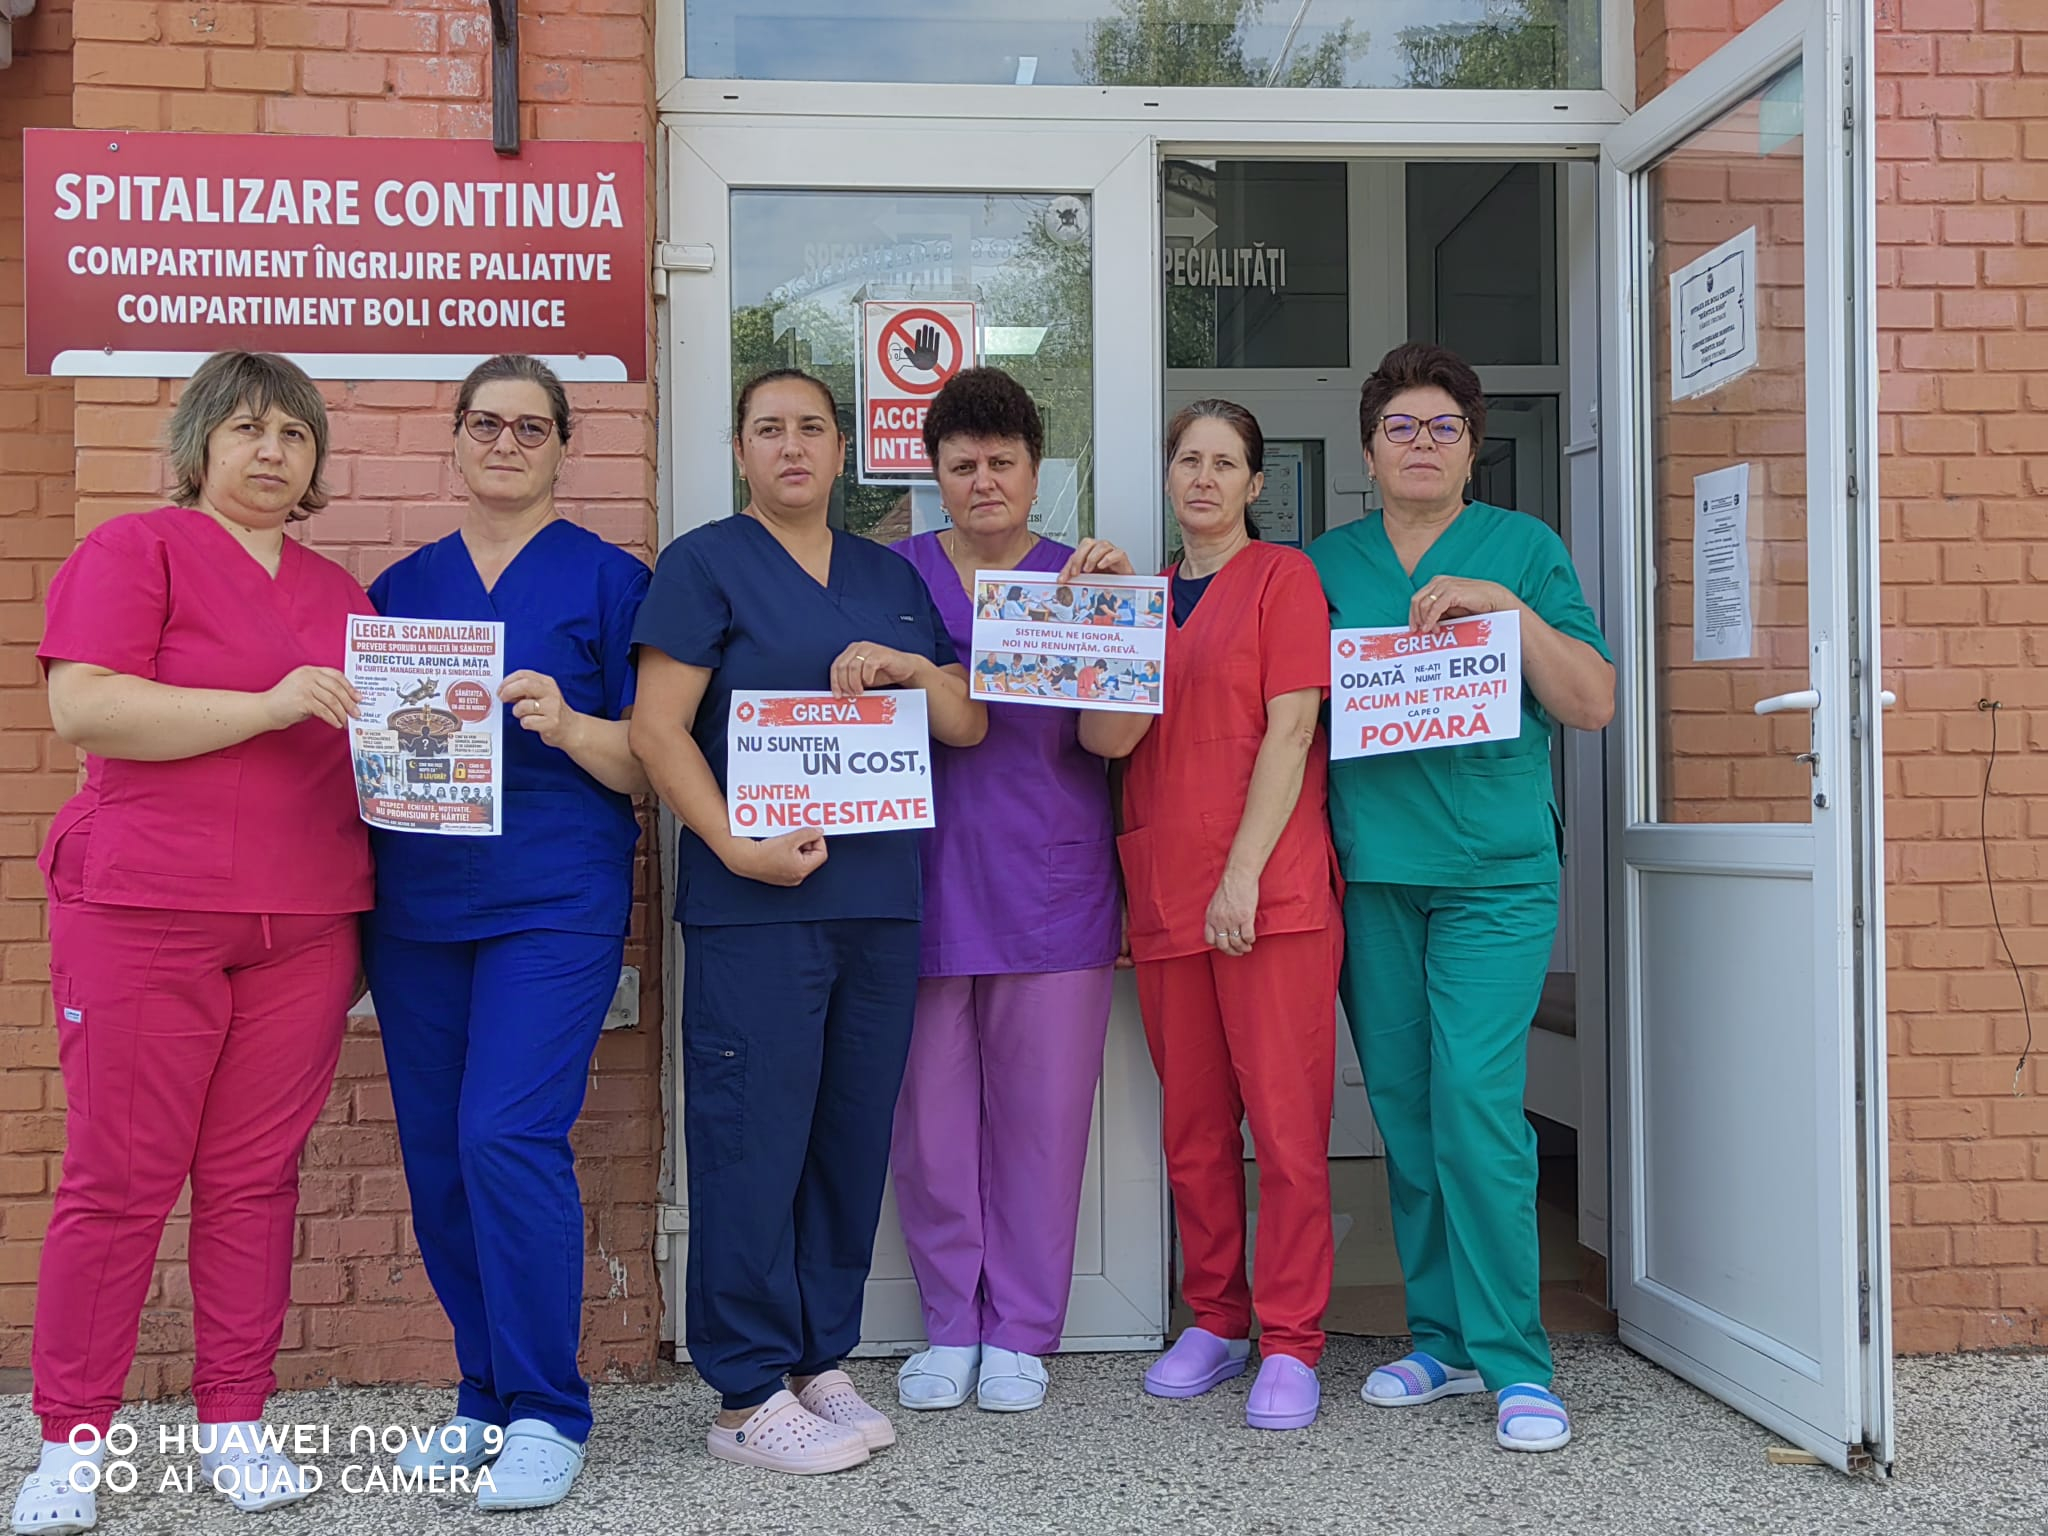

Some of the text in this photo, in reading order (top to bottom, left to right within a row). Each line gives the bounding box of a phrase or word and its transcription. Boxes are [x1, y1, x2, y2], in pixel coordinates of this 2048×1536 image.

[54, 172, 624, 228] SPITALIZARE CONTINUĂ
[68, 243, 612, 281] COMPARTIMENT ÎNGRIJIRE PALIATIVE
[1165, 241, 1286, 295] PECIALITĂȚI
[117, 294, 567, 328] COMPARTIMENT BOLI CRONICE
[873, 407, 929, 430] ACCE
[355, 623, 490, 641] LEGEA SCANDALIZĂRII
[1015, 628, 1124, 642] SISTEMUL NE IGNORĂ.
[1394, 627, 1458, 654] GREVĂ
[356, 641, 387, 651] PREVEDE
[418, 643, 427, 652] LA
[1002, 640, 1020, 648] NOI
[1023, 641, 1038, 649] NU
[1103, 644, 1139, 655] GREVĂ.
[359, 654, 415, 666] PROIECTUL
[418, 656, 460, 667] ARUNCĂ
[364, 665, 388, 673] CURTEA
[1340, 664, 1405, 689] ODATĂ
[1449, 652, 1506, 678] EROI
[1416, 673, 1442, 684] NUMIT
[1344, 679, 1507, 712] ACUM NE TRATAȚI
[792, 697, 861, 722] GREVĂ
[1407, 707, 1440, 718] CA PE O
[1360, 702, 1491, 749] POVARĂ
[737, 736, 840, 752] NU SUNTEM
[803, 751, 926, 776] UN COST,
[736, 784, 810, 800] SUNTEM
[376, 806, 386, 815] NU
[386, 808, 429, 820] PROMISIUNI
[430, 812, 440, 821] PE
[735, 798, 928, 827] O NECESITATE
